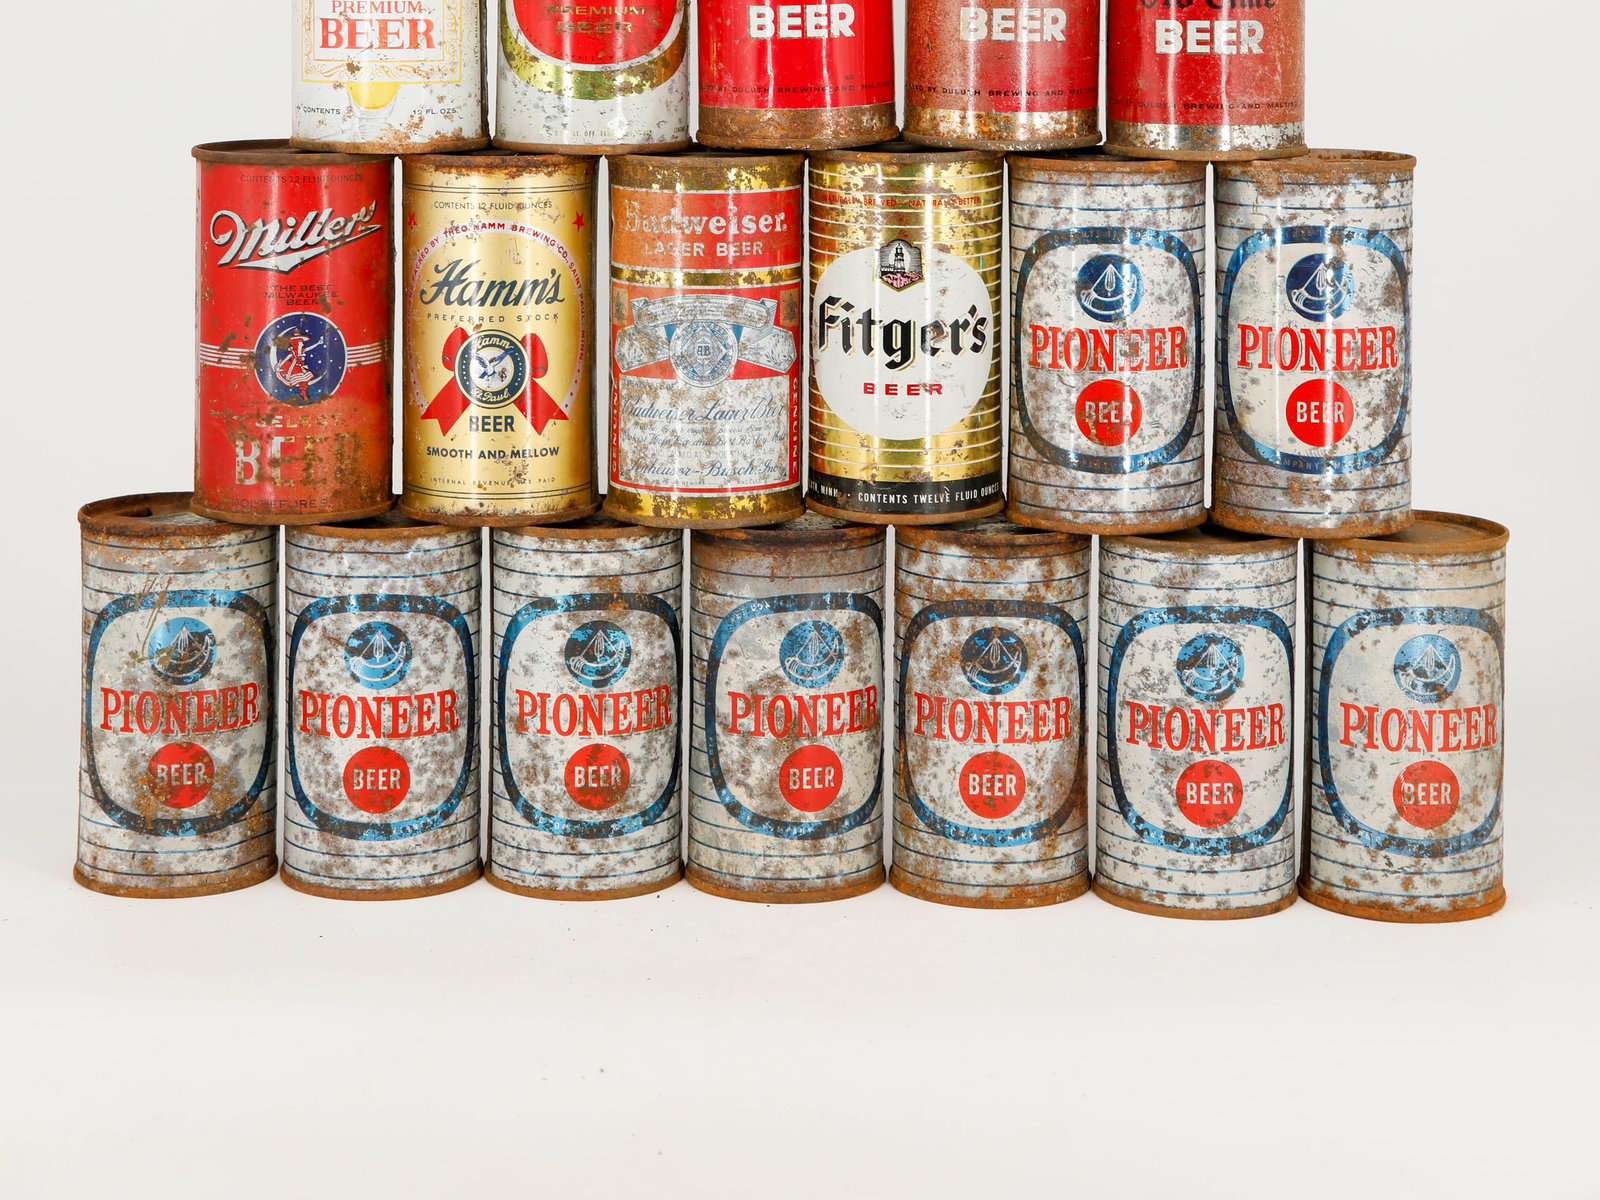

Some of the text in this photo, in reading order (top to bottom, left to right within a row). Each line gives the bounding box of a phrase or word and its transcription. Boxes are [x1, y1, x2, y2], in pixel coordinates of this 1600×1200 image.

[331, 0, 424, 14] PREMIUM
[546, 4, 646, 16] PREMIUM
[318, 17, 436, 50] BEER
[557, 21, 633, 34] BEER
[747, 2, 856, 40] BEER
[959, 6, 1067, 43] BEER
[1154, 18, 1265, 55] BEER
[303, 105, 341, 115] CONTENTS
[289, 175, 300, 184] 12
[433, 200, 475, 210] CONTENTS
[489, 202, 514, 210] FLUID
[429, 237, 440, 248] BY
[511, 224, 556, 247] BREWING
[643, 241, 764, 257] LAGER BEER
[264, 290, 339, 298] MILWAUKEE
[270, 284, 332, 292] THE BEST
[419, 258, 565, 307] Hamm's
[286, 298, 319, 306] BEER
[427, 312, 559, 323] PREFERRED STOCK
[818, 294, 988, 372] Fitger's
[1028, 323, 1189, 373] PIONEER
[1237, 323, 1400, 372] PIONEER
[863, 382, 943, 396] BEER
[469, 415, 516, 433] BEER
[1295, 400, 1346, 424] BEER
[426, 446, 560, 460] SMOOTH AND MELLOW
[858, 492, 908, 504] CONTENTS
[913, 491, 951, 504] TWELVE
[955, 488, 978, 501] FLUID
[100, 681, 262, 736] PIONEER
[299, 688, 461, 740] PIONEER
[515, 684, 673, 738] PIONEER
[727, 685, 879, 739] PIONEER
[913, 691, 1073, 745] PIONEER
[1125, 700, 1286, 754] PIONEER
[1339, 700, 1499, 753] PIONEER
[155, 762, 207, 788] BEER
[352, 767, 402, 792] BEER
[573, 764, 623, 789] BEER
[788, 766, 836, 791] BEER
[968, 772, 1017, 797] BEER
[1185, 782, 1235, 806] BEER
[1401, 781, 1452, 806] BEER
